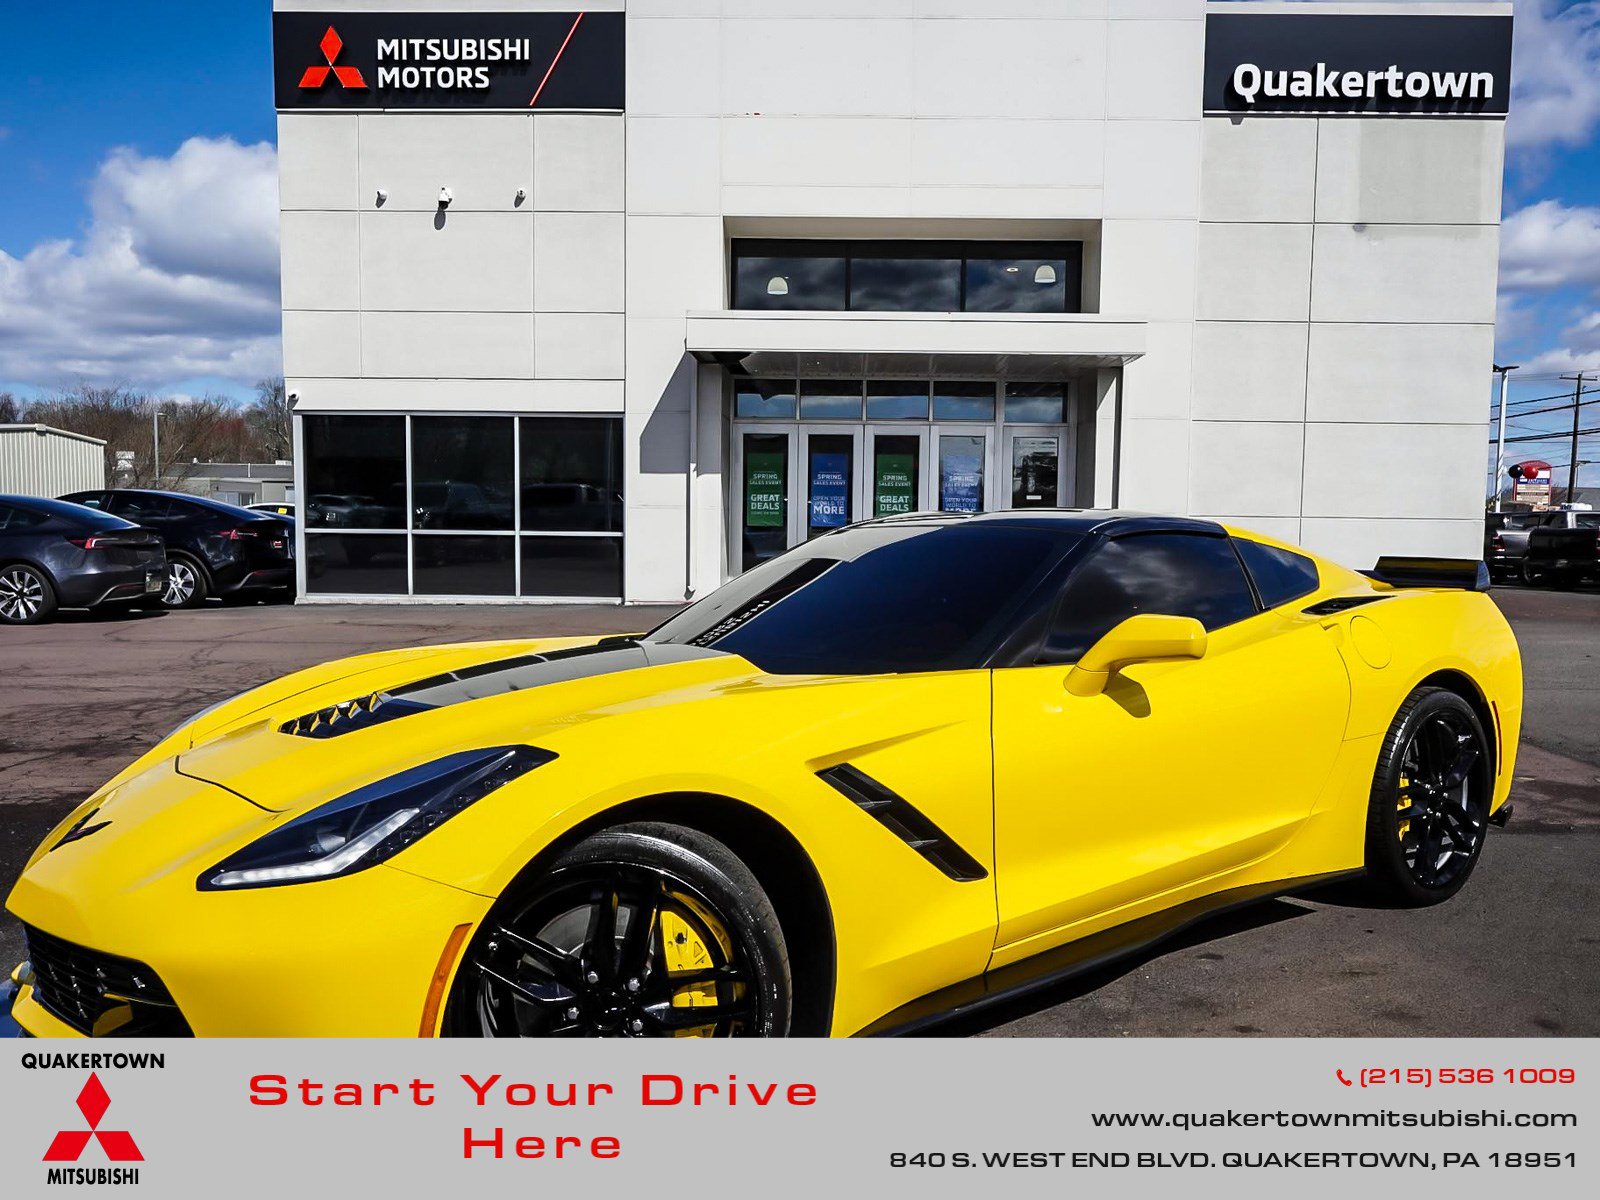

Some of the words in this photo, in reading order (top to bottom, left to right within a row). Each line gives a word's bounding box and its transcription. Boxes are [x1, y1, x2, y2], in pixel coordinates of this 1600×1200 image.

[377, 38, 530, 61] MITSUBISHI
[377, 66, 490, 89] MOTORS
[1233, 62, 1494, 104] Quakertown
[750, 494, 780, 502] GREAT
[879, 495, 910, 504] GREAT
[750, 502, 780, 510] DEALS
[813, 505, 845, 515] MORE
[880, 503, 909, 512] DEALS
